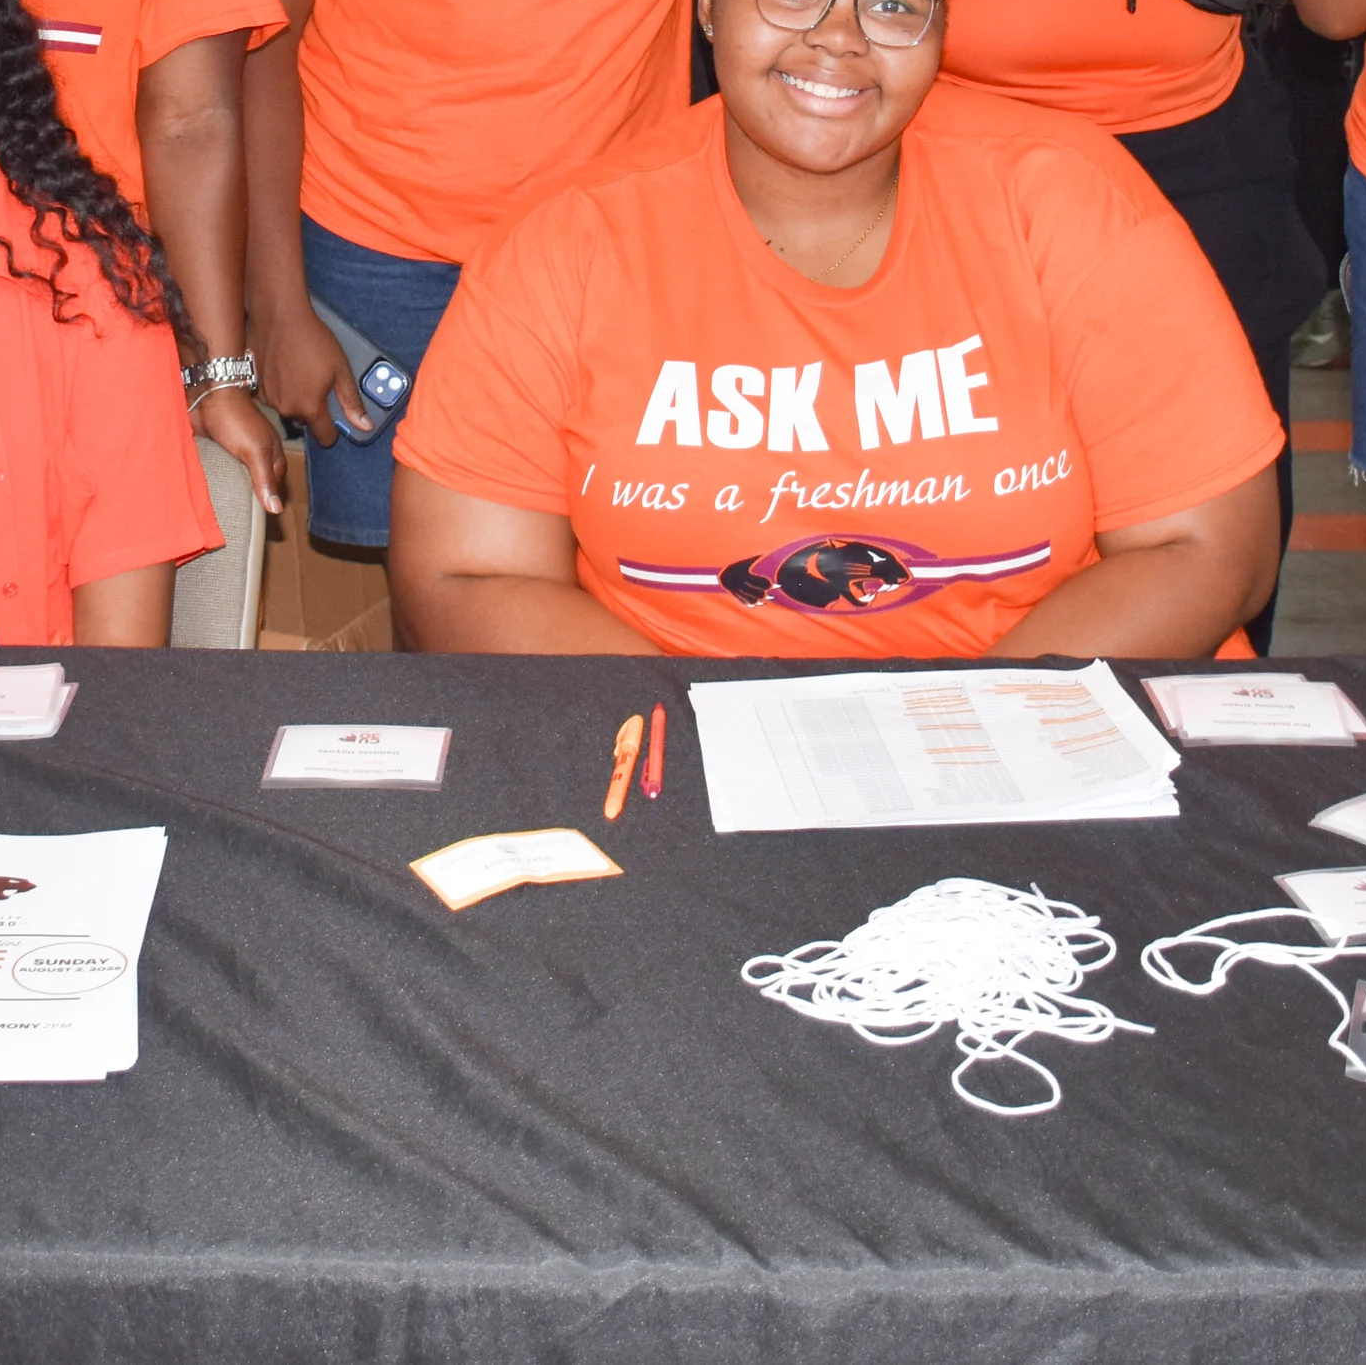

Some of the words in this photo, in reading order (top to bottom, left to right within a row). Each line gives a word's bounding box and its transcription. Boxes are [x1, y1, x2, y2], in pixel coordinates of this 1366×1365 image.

[635, 360, 830, 452] ASK
[854, 334, 999, 450] ME
[581, 464, 596, 495] I
[612, 479, 689, 511] was
[714, 483, 744, 512] a
[759, 468, 971, 524] freshman
[993, 449, 1073, 496] once
[33, 958, 110, 966] SUNDAY
